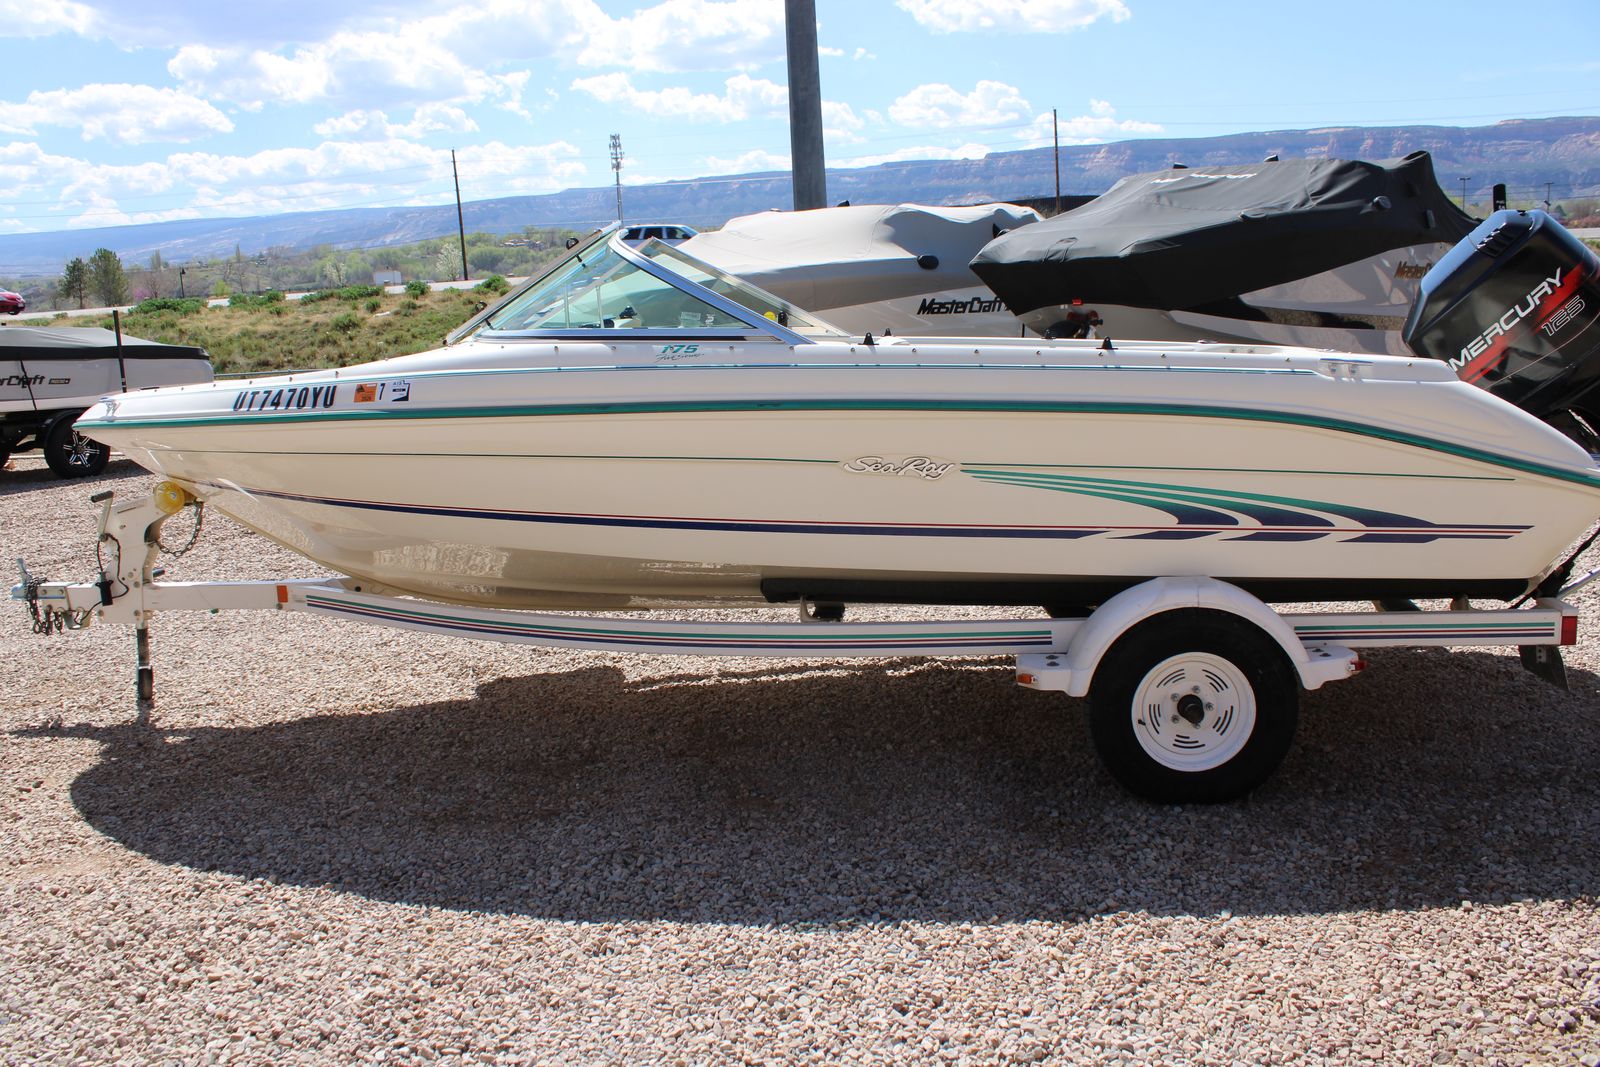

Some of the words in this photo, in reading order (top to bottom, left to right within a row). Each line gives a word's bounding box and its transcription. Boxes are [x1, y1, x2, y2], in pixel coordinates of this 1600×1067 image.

[1448, 267, 1564, 372] MERCURY
[1541, 295, 1586, 337] 125
[661, 344, 699, 354] 175
[843, 456, 899, 473] Sea
[897, 456, 955, 480] Ray
